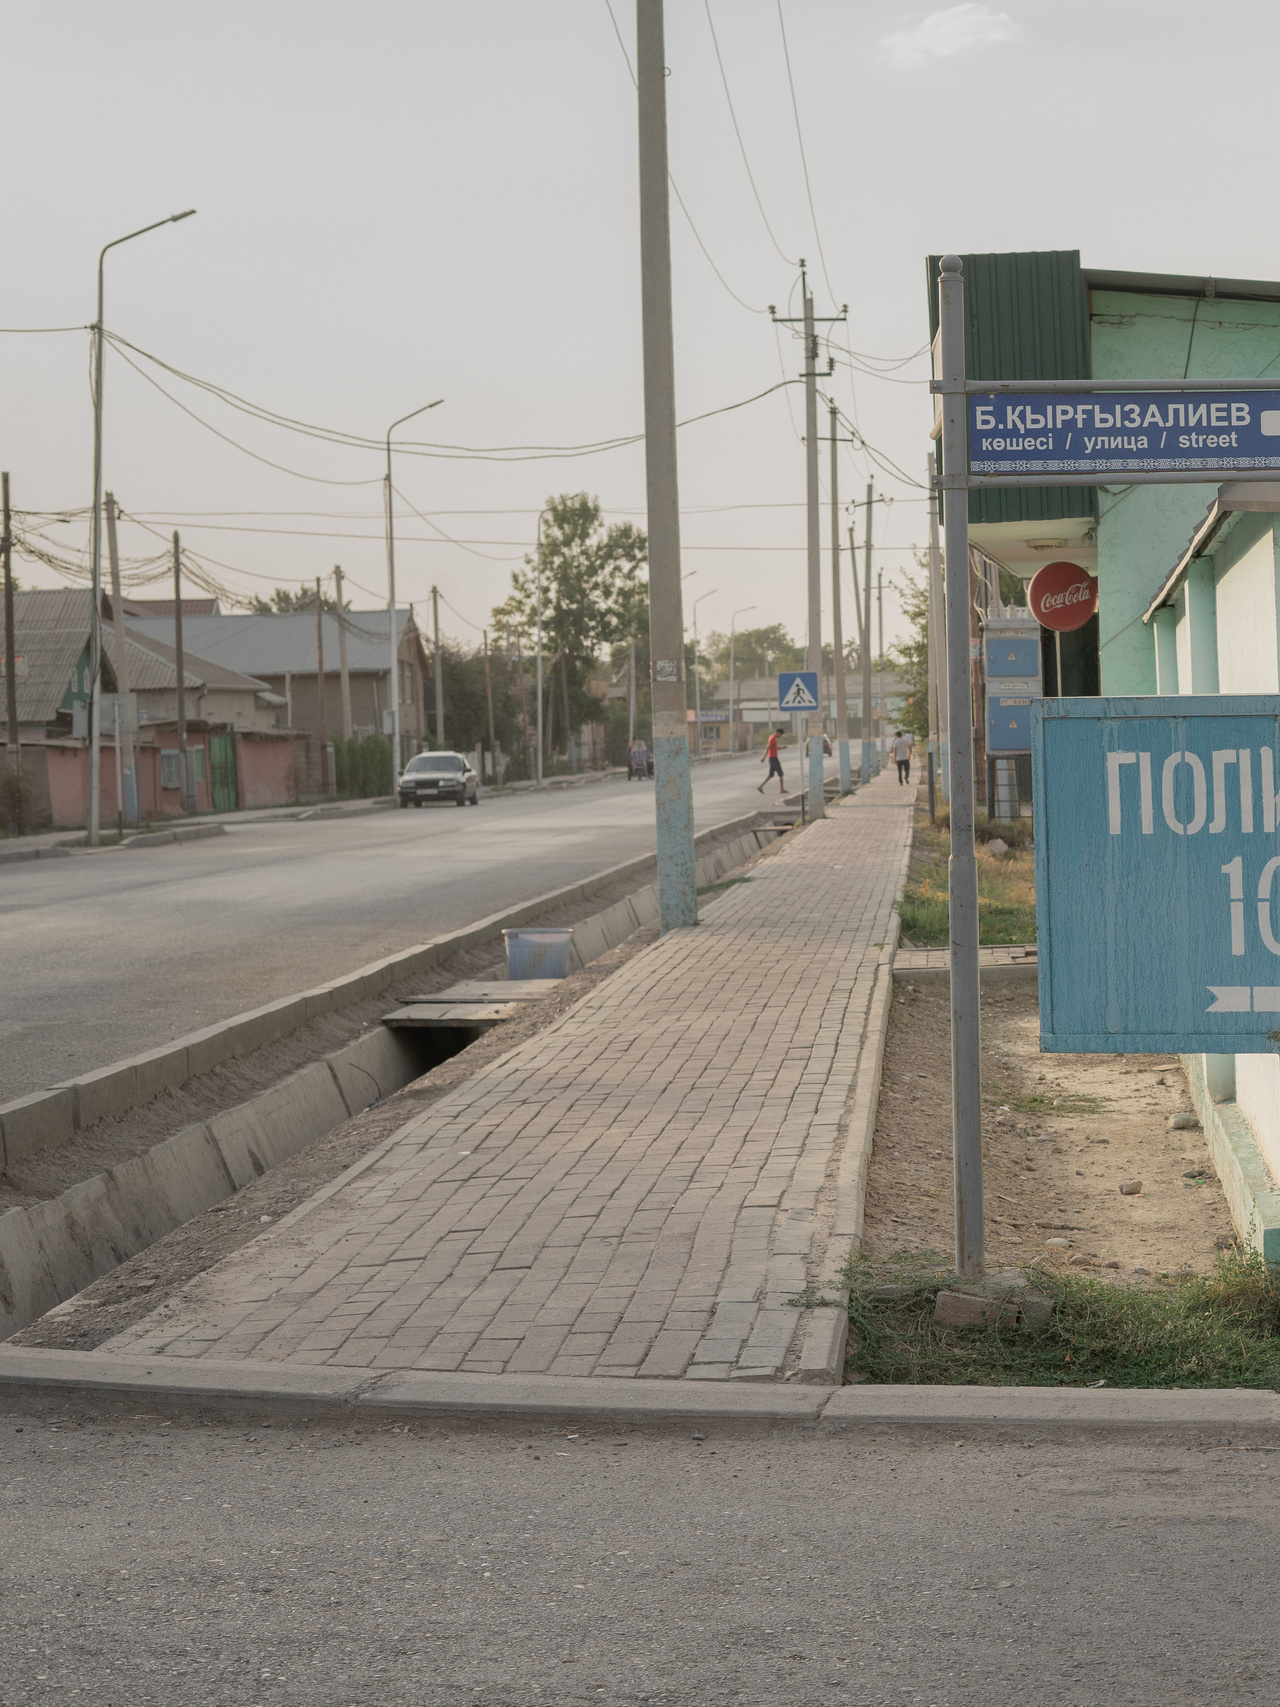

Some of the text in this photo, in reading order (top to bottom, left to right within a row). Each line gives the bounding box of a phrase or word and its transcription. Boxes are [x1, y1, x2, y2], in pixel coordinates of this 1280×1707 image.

[976, 402, 1251, 433] Б.ҚЫРҒЫЗАЛИЕВ
[982, 433, 1053, 451] көшесі
[1084, 434, 1148, 453] улица
[1178, 431, 1238, 448] street
[1041, 581, 1090, 612] Coca-Cola
